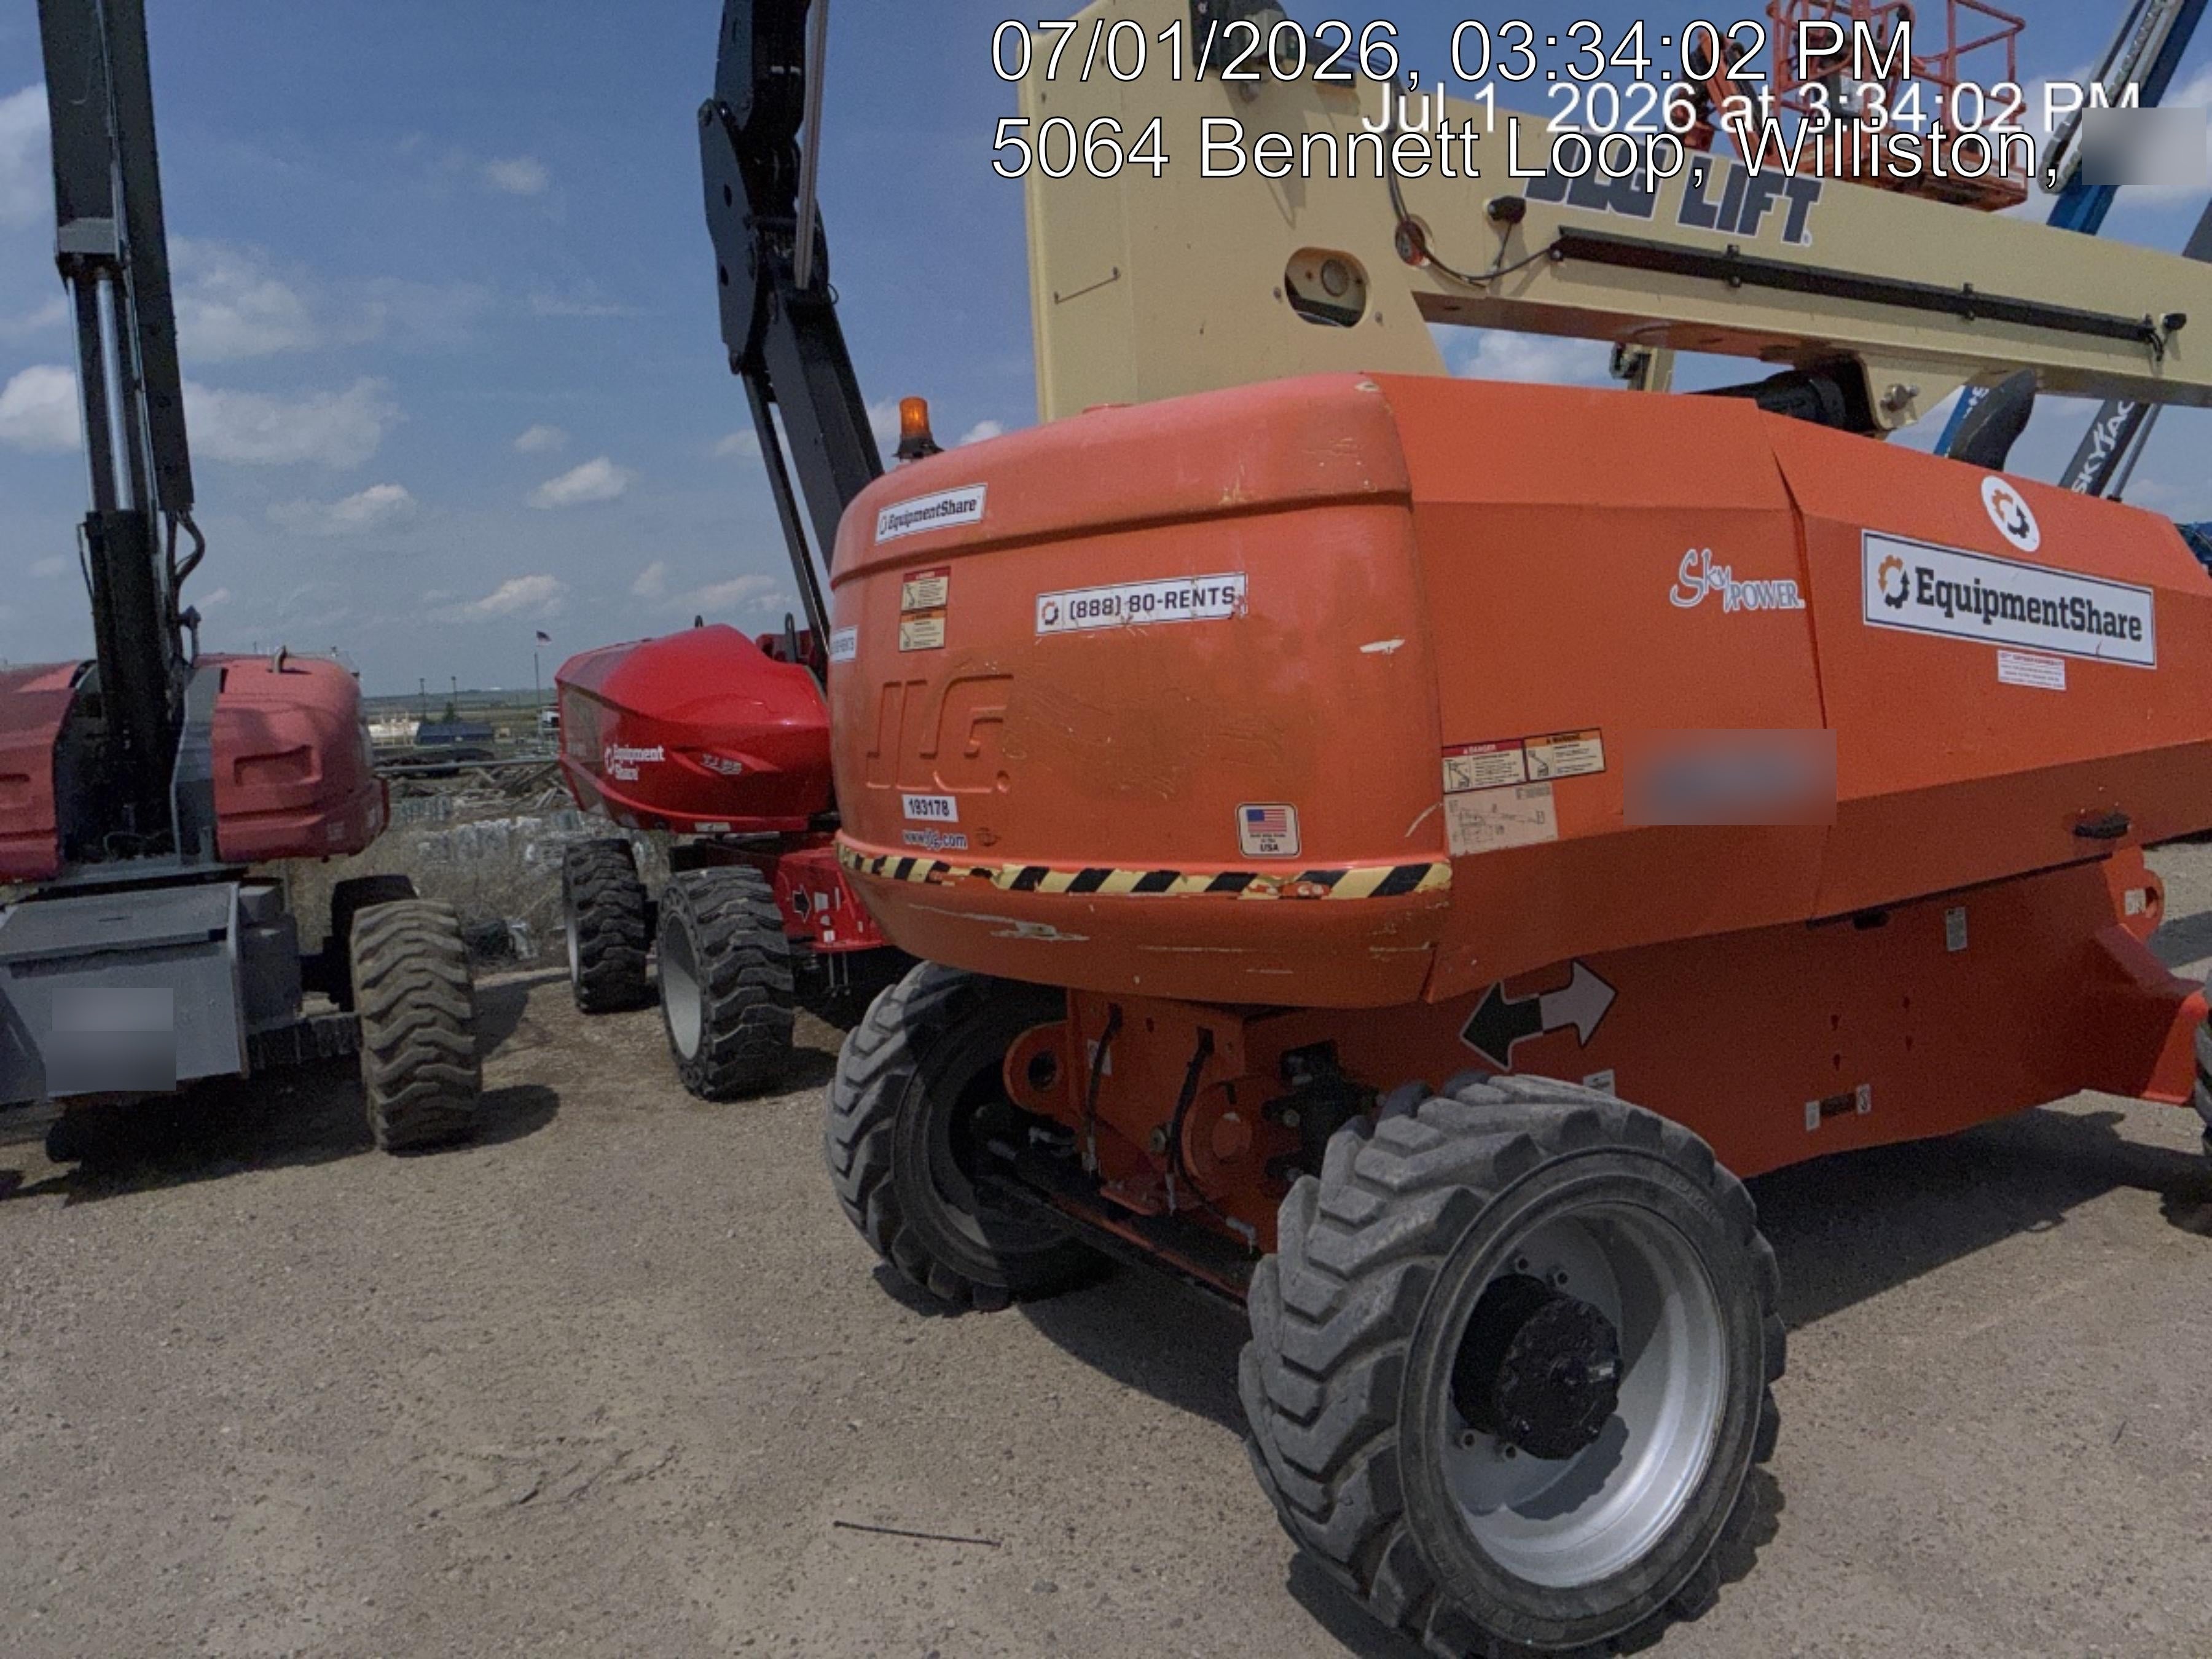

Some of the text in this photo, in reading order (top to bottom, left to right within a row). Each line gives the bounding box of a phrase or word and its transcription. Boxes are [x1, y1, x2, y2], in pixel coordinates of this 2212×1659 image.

[1677, 154, 1824, 245] LIFT
[2071, 401, 2135, 494] SKYJAC
[1070, 585, 1236, 621] (888) 80-RENTS
[1915, 566, 2143, 642] EquipmentShare
[909, 799, 949, 817] 193178
